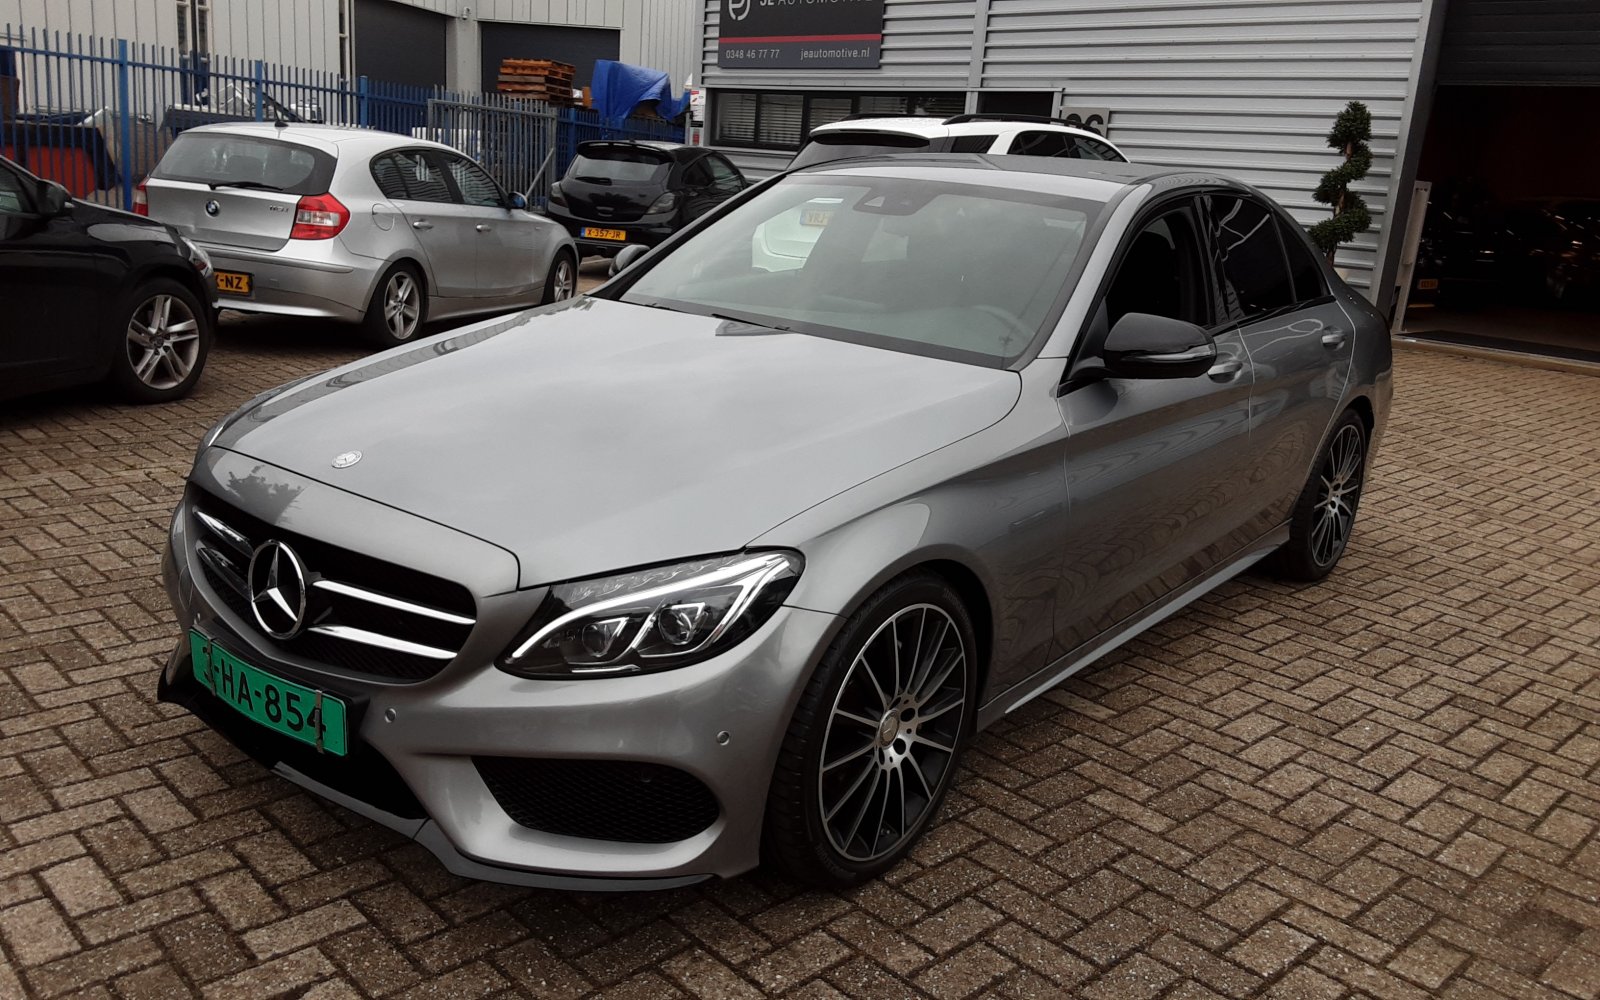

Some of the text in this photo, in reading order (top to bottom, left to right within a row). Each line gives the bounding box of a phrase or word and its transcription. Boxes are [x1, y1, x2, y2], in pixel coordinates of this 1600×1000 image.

[726, 49, 780, 59] 0348 46 77 77
[800, 47, 870, 60] jeautomotive.nl
[587, 228, 621, 239] X-357-JR
